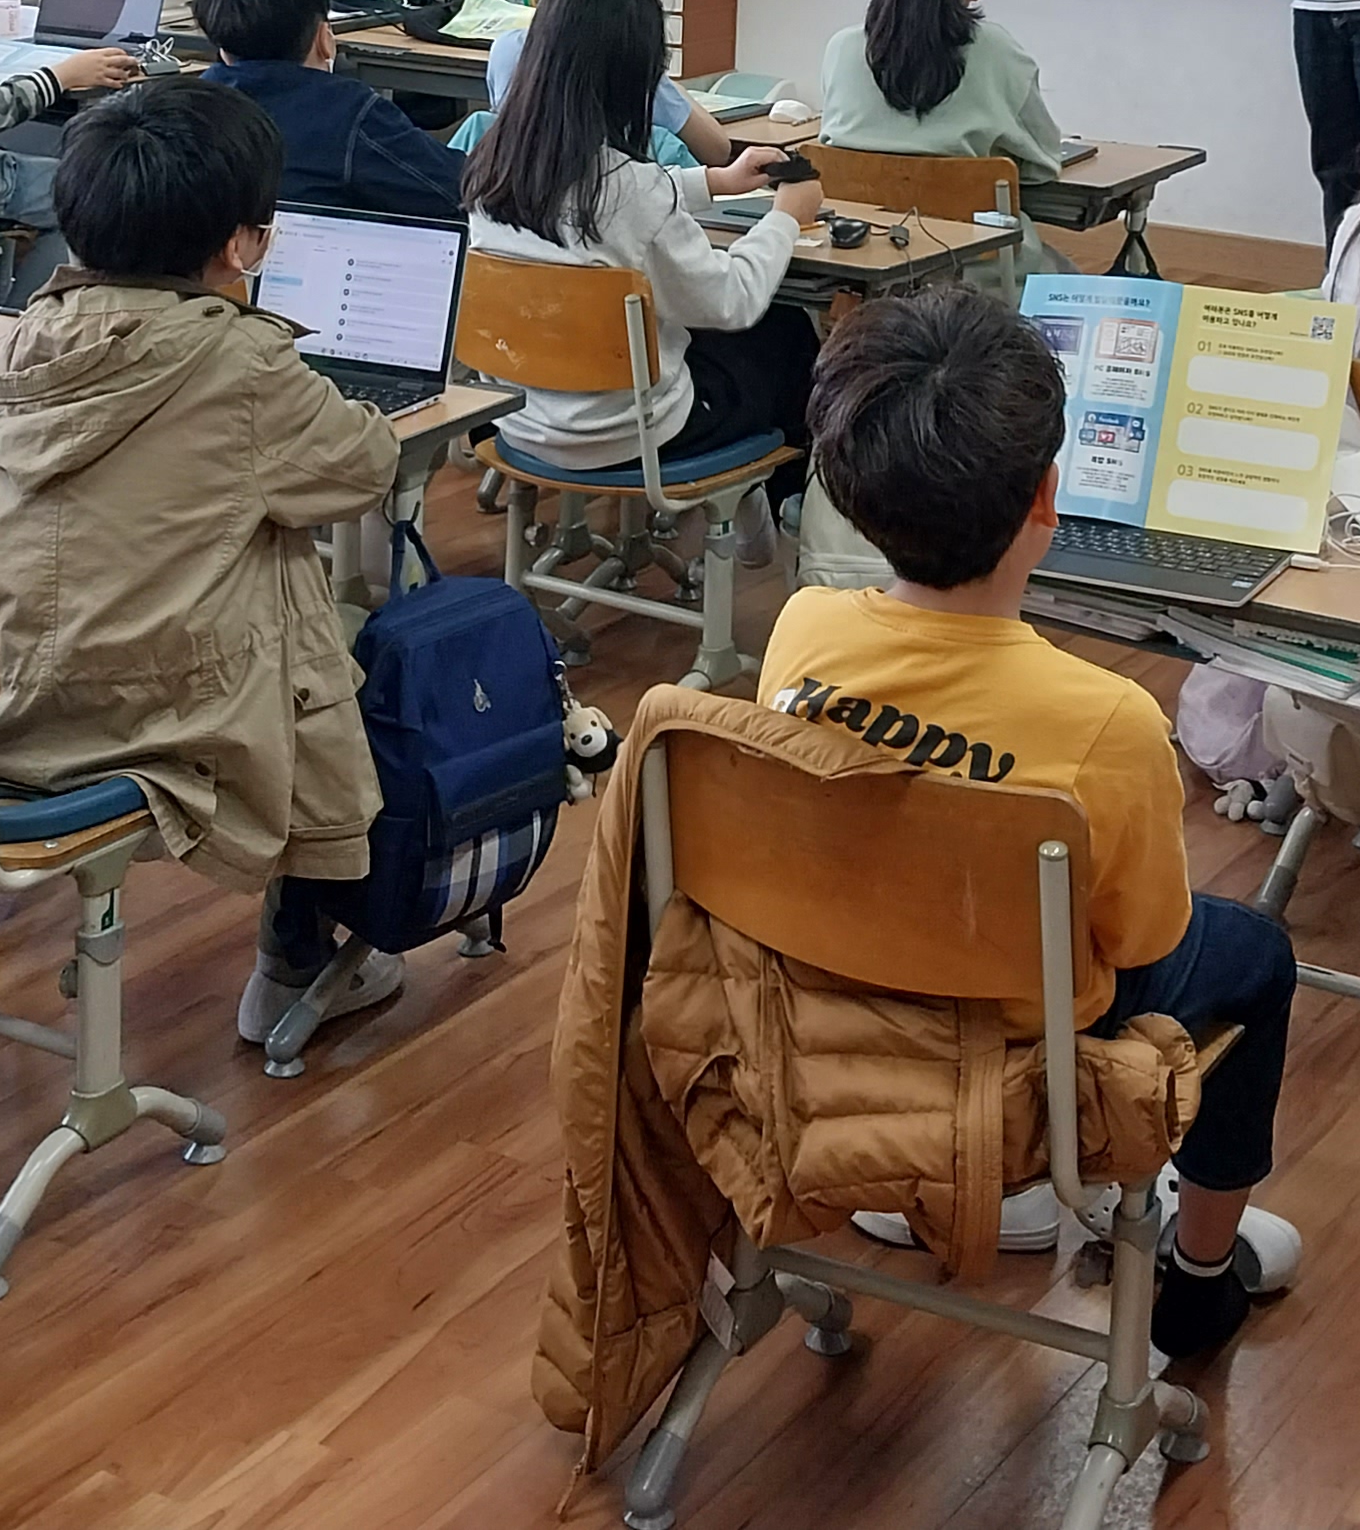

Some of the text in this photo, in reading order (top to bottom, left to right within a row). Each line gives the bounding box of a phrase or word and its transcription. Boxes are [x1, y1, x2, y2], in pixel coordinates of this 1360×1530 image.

[1197, 340, 1212, 352] 01
[1186, 401, 1204, 415] 02
[1176, 463, 1194, 478] 03
